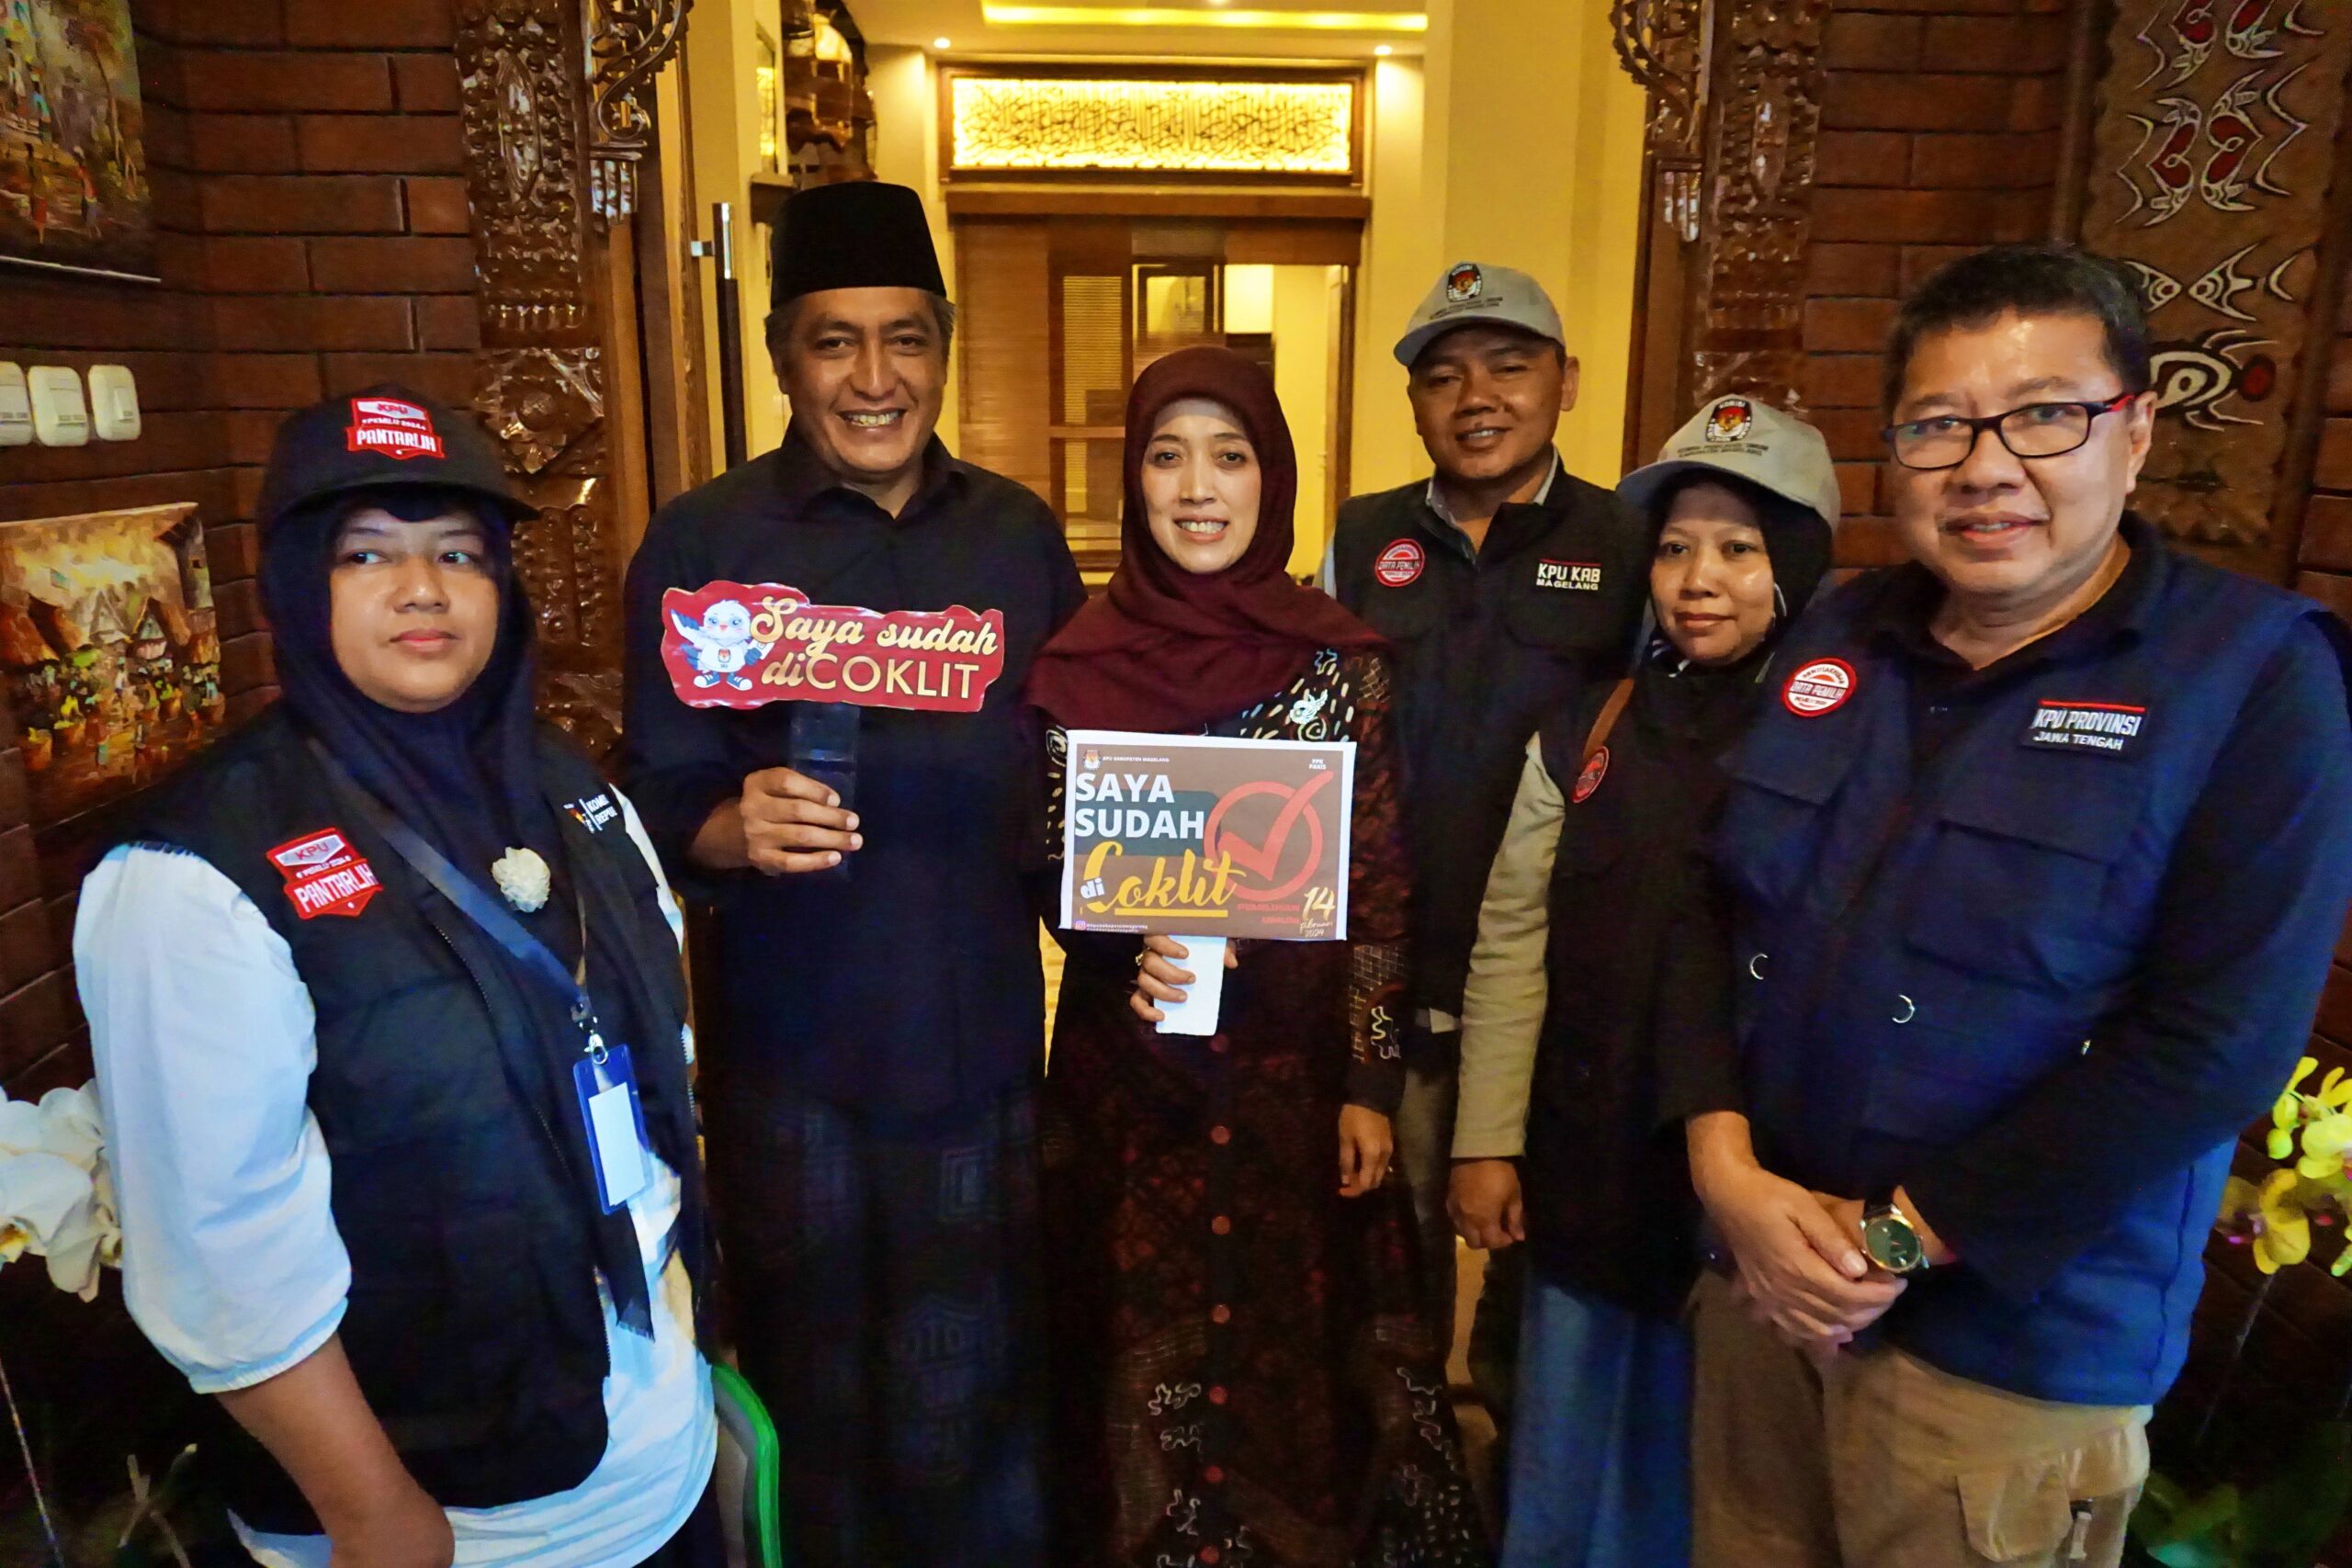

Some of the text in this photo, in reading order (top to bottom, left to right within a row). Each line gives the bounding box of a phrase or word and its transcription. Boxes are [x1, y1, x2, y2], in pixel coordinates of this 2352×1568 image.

[378, 403, 408, 414] KPU
[356, 428, 436, 452] PANTARLIH
[1536, 578, 1599, 591] MAGELANG
[1538, 563, 1600, 582] KPU KAB
[751, 595, 998, 659] Saya sudah
[2030, 708, 2142, 737] KPU PROVINSI
[2033, 731, 2124, 750] JAWA TENGAH
[1075, 773, 1175, 803] SAYA
[1074, 808, 1204, 840] SUDAH
[295, 842, 329, 860] KPU
[294, 863, 379, 913] PANTARLIH
[1080, 877, 1105, 899] di
[1302, 886, 1336, 921] 14
